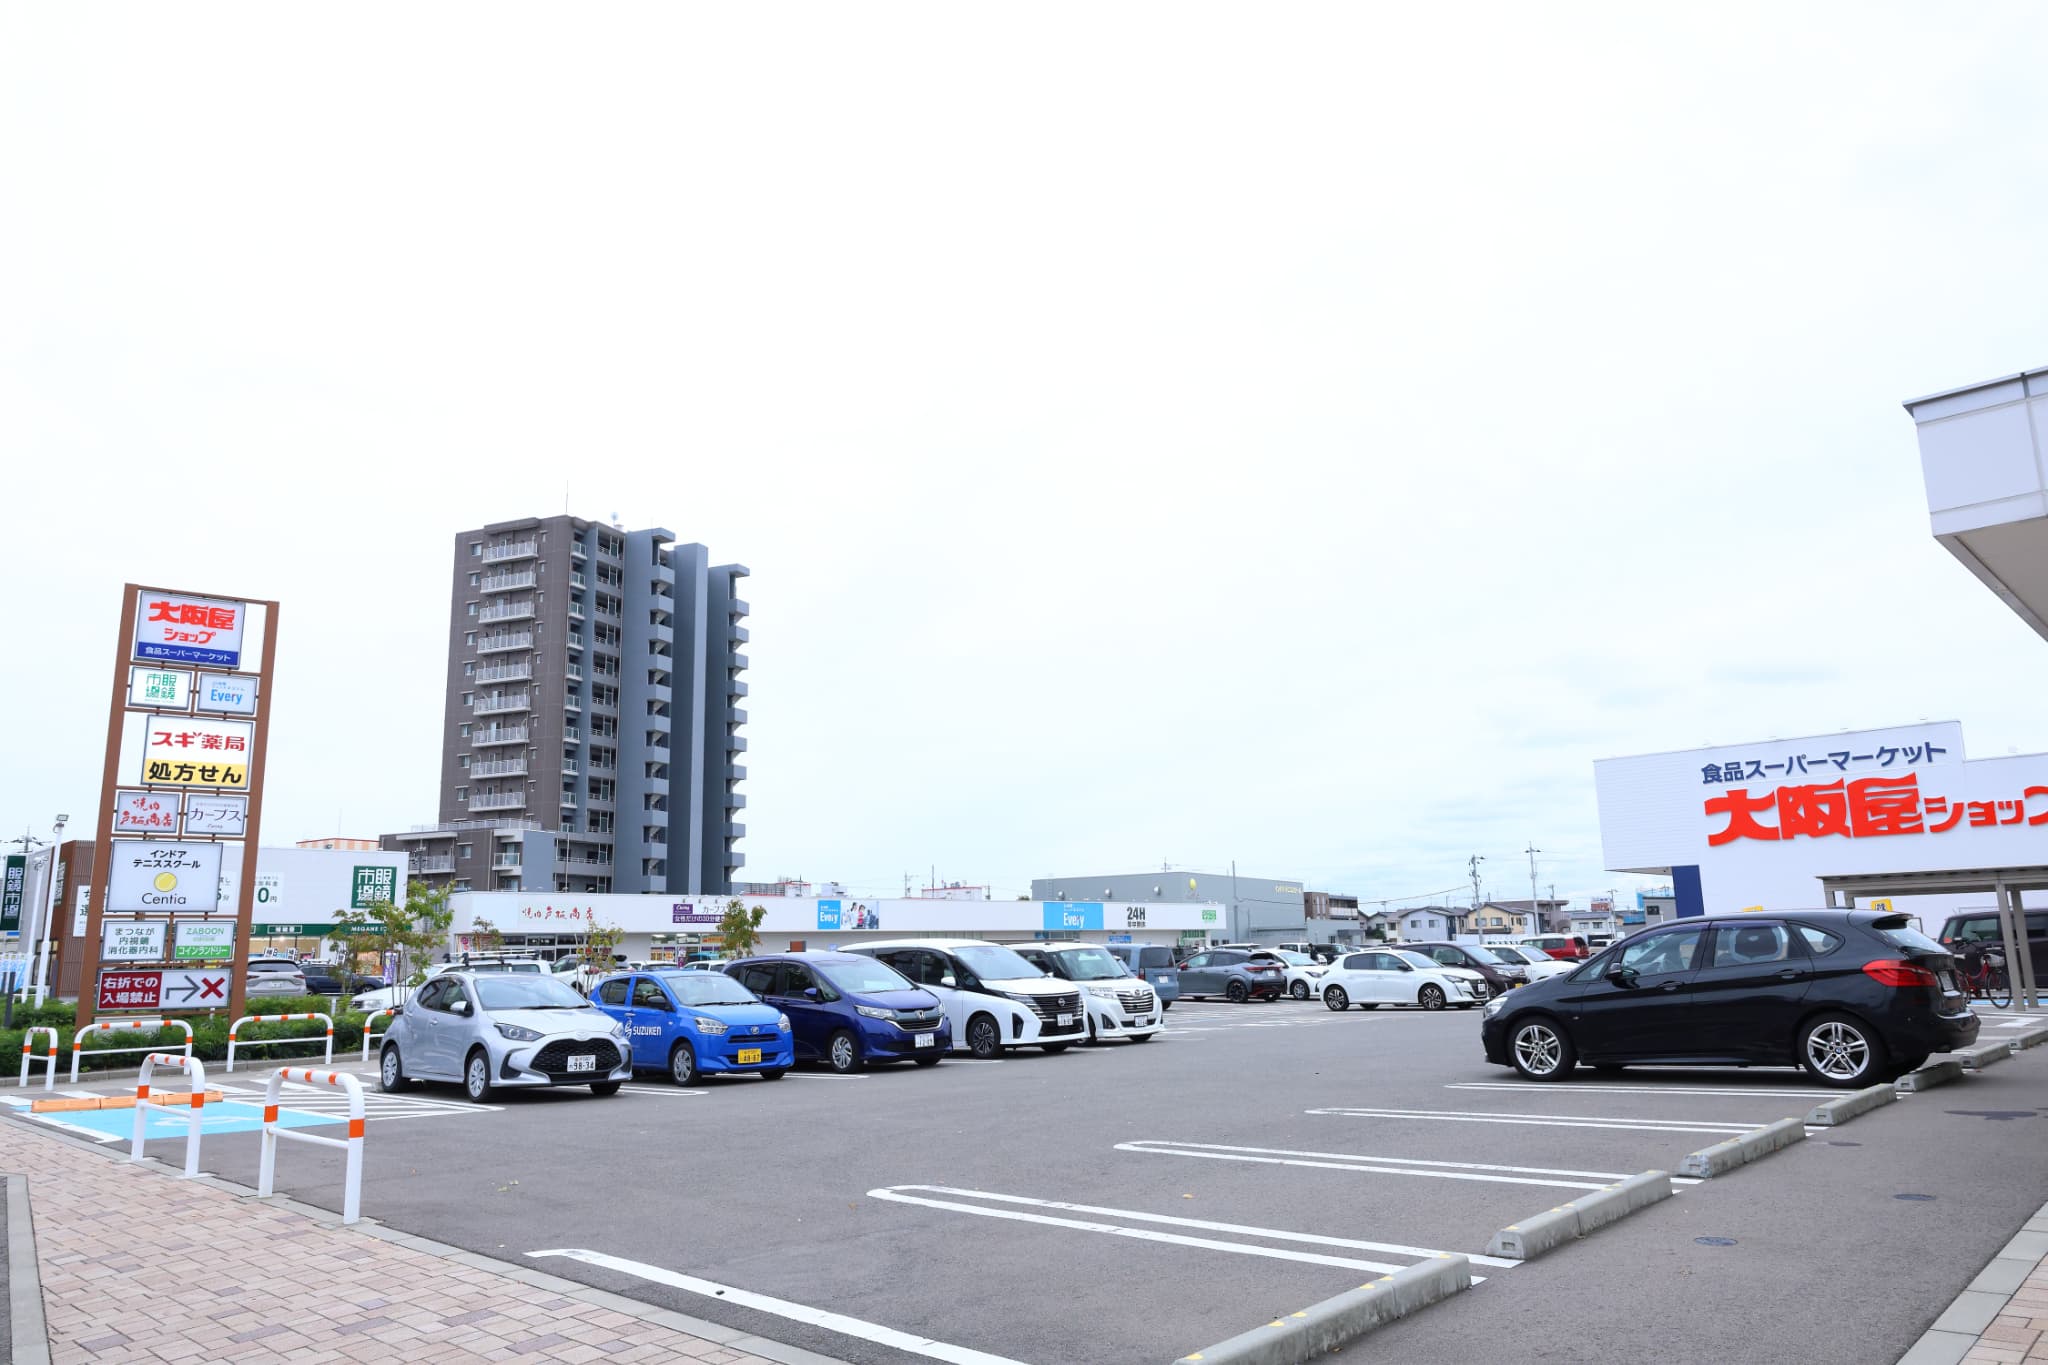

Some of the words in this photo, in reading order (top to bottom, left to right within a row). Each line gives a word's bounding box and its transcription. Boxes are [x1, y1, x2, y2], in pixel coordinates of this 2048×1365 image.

[148, 601, 235, 630] 大阪屋
[164, 628, 216, 644] ショップ
[145, 647, 231, 662] 食品スーパーマーケット
[210, 688, 243, 705] Every
[152, 731, 245, 751] スギ薬局
[1700, 741, 1947, 784] 食品スーパーマーケット
[149, 761, 242, 784] 処方せん
[190, 807, 241, 823] カーブス
[150, 849, 187, 859] インドア
[133, 858, 201, 869] テニススクール
[142, 892, 187, 905] Centia
[1063, 912, 1085, 928] Every
[1127, 906, 1146, 920] 24H
[115, 927, 155, 936] まつなが
[186, 927, 225, 936] ZABOON
[107, 945, 159, 955] 消化器内科
[178, 946, 227, 957] コインランドリー
[103, 976, 158, 990] 右折での
[102, 991, 157, 1004] 入場禁止
[633, 1026, 662, 1036] SUZUKEN
